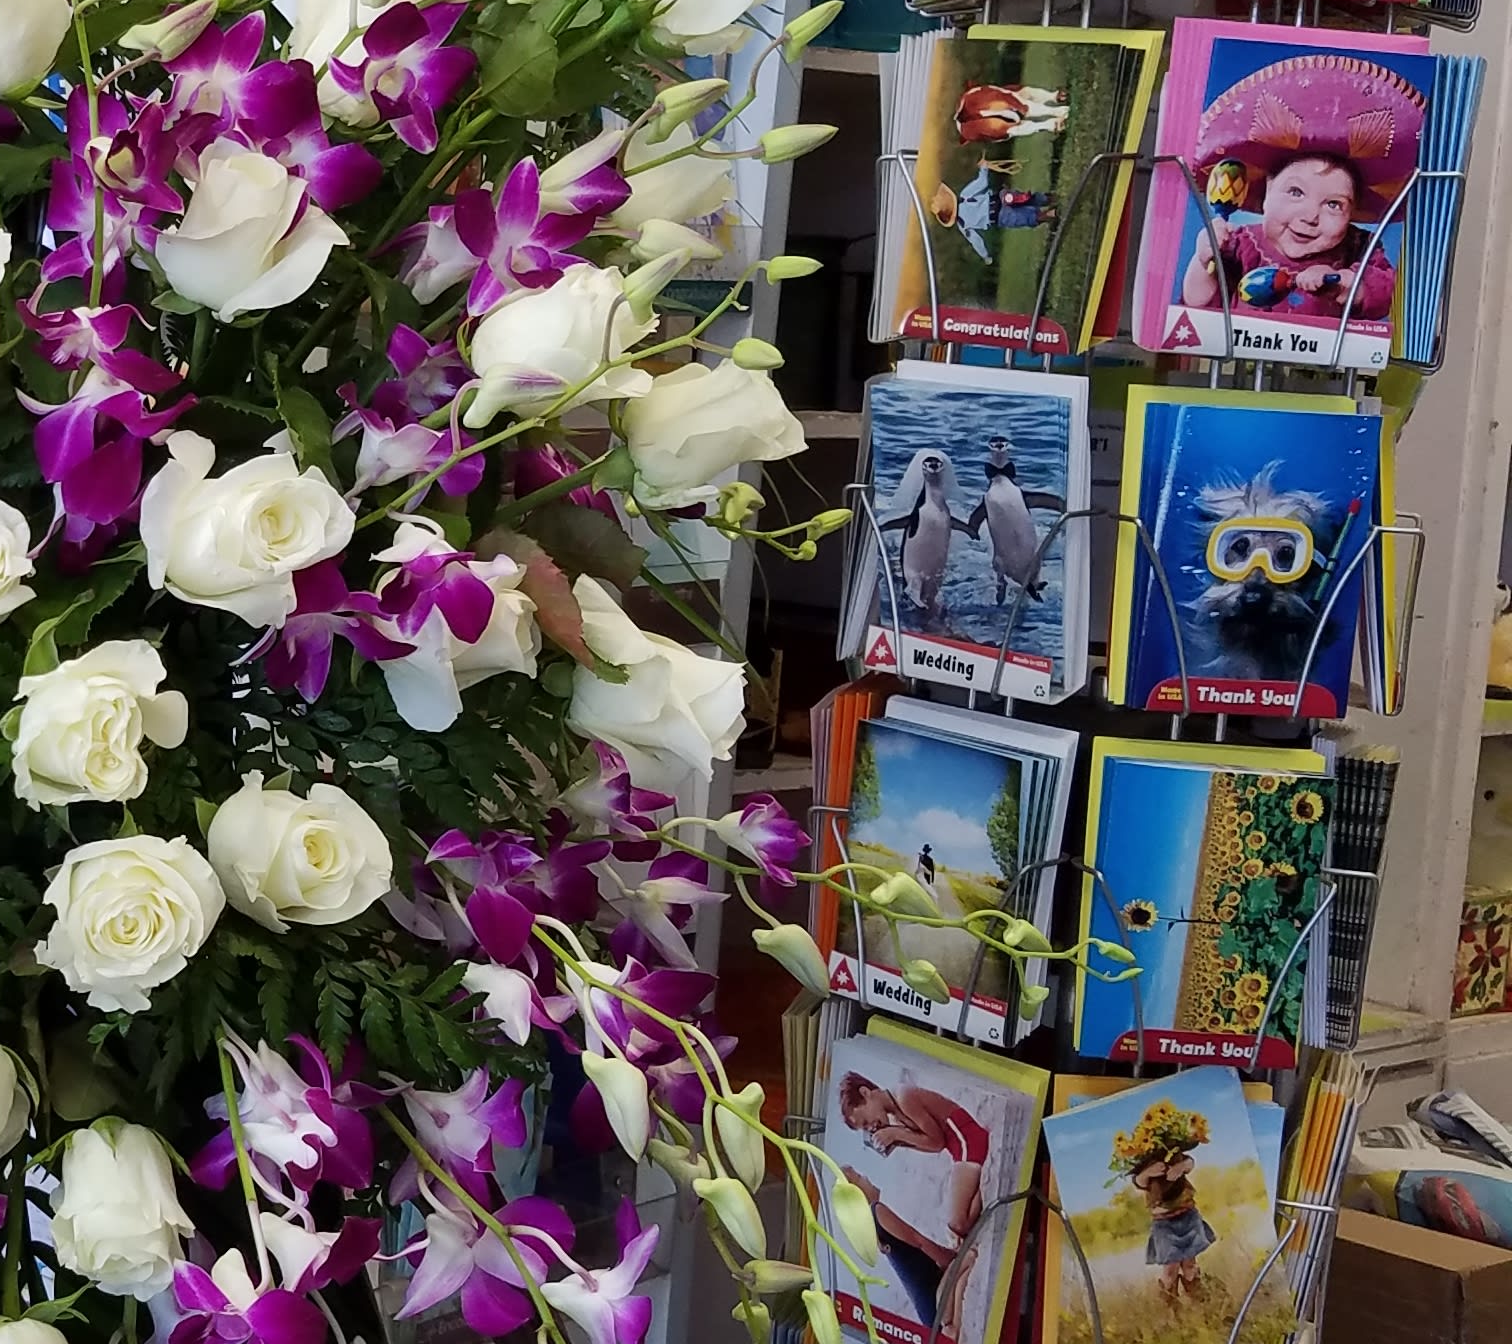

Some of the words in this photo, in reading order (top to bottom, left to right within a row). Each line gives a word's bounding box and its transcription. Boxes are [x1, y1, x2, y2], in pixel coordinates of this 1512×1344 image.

[943, 318, 1060, 344] Congratulatons
[1233, 328, 1284, 350] Thank
[1290, 333, 1319, 353] You
[913, 649, 975, 682] Wedding
[1197, 686, 1256, 704] Thank
[1261, 689, 1296, 706] You
[873, 978, 932, 1016] Wedding
[1159, 1038, 1216, 1056] Thank
[1221, 1042, 1256, 1058] You
